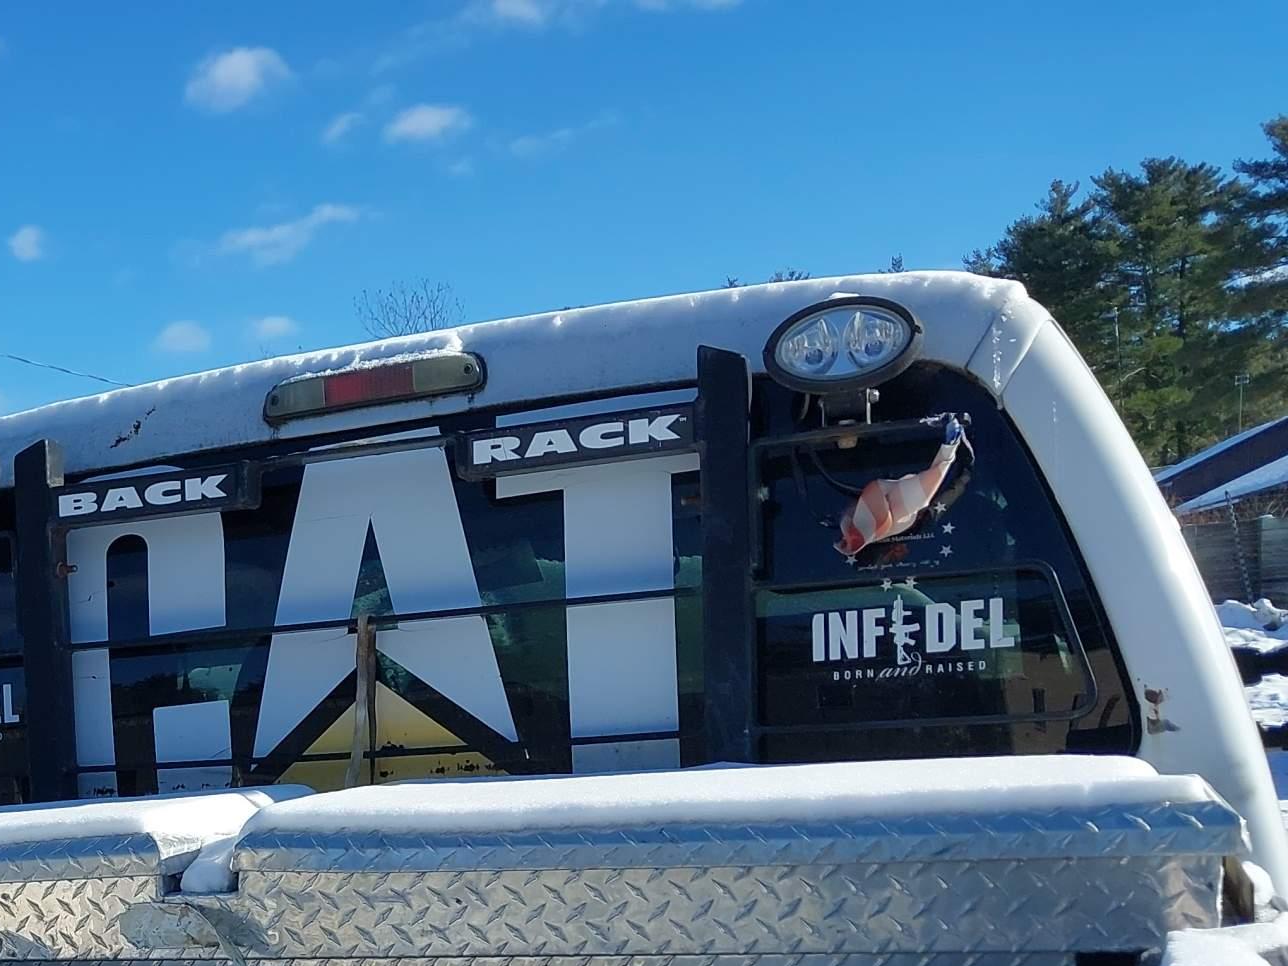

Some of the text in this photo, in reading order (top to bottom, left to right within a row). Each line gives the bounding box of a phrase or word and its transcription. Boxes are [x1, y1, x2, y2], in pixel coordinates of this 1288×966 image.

[58, 474, 228, 518] BACK
[472, 414, 681, 465] RACK
[67, 389, 699, 797] CAT
[833, 651, 987, 681] BORN and RAISED
